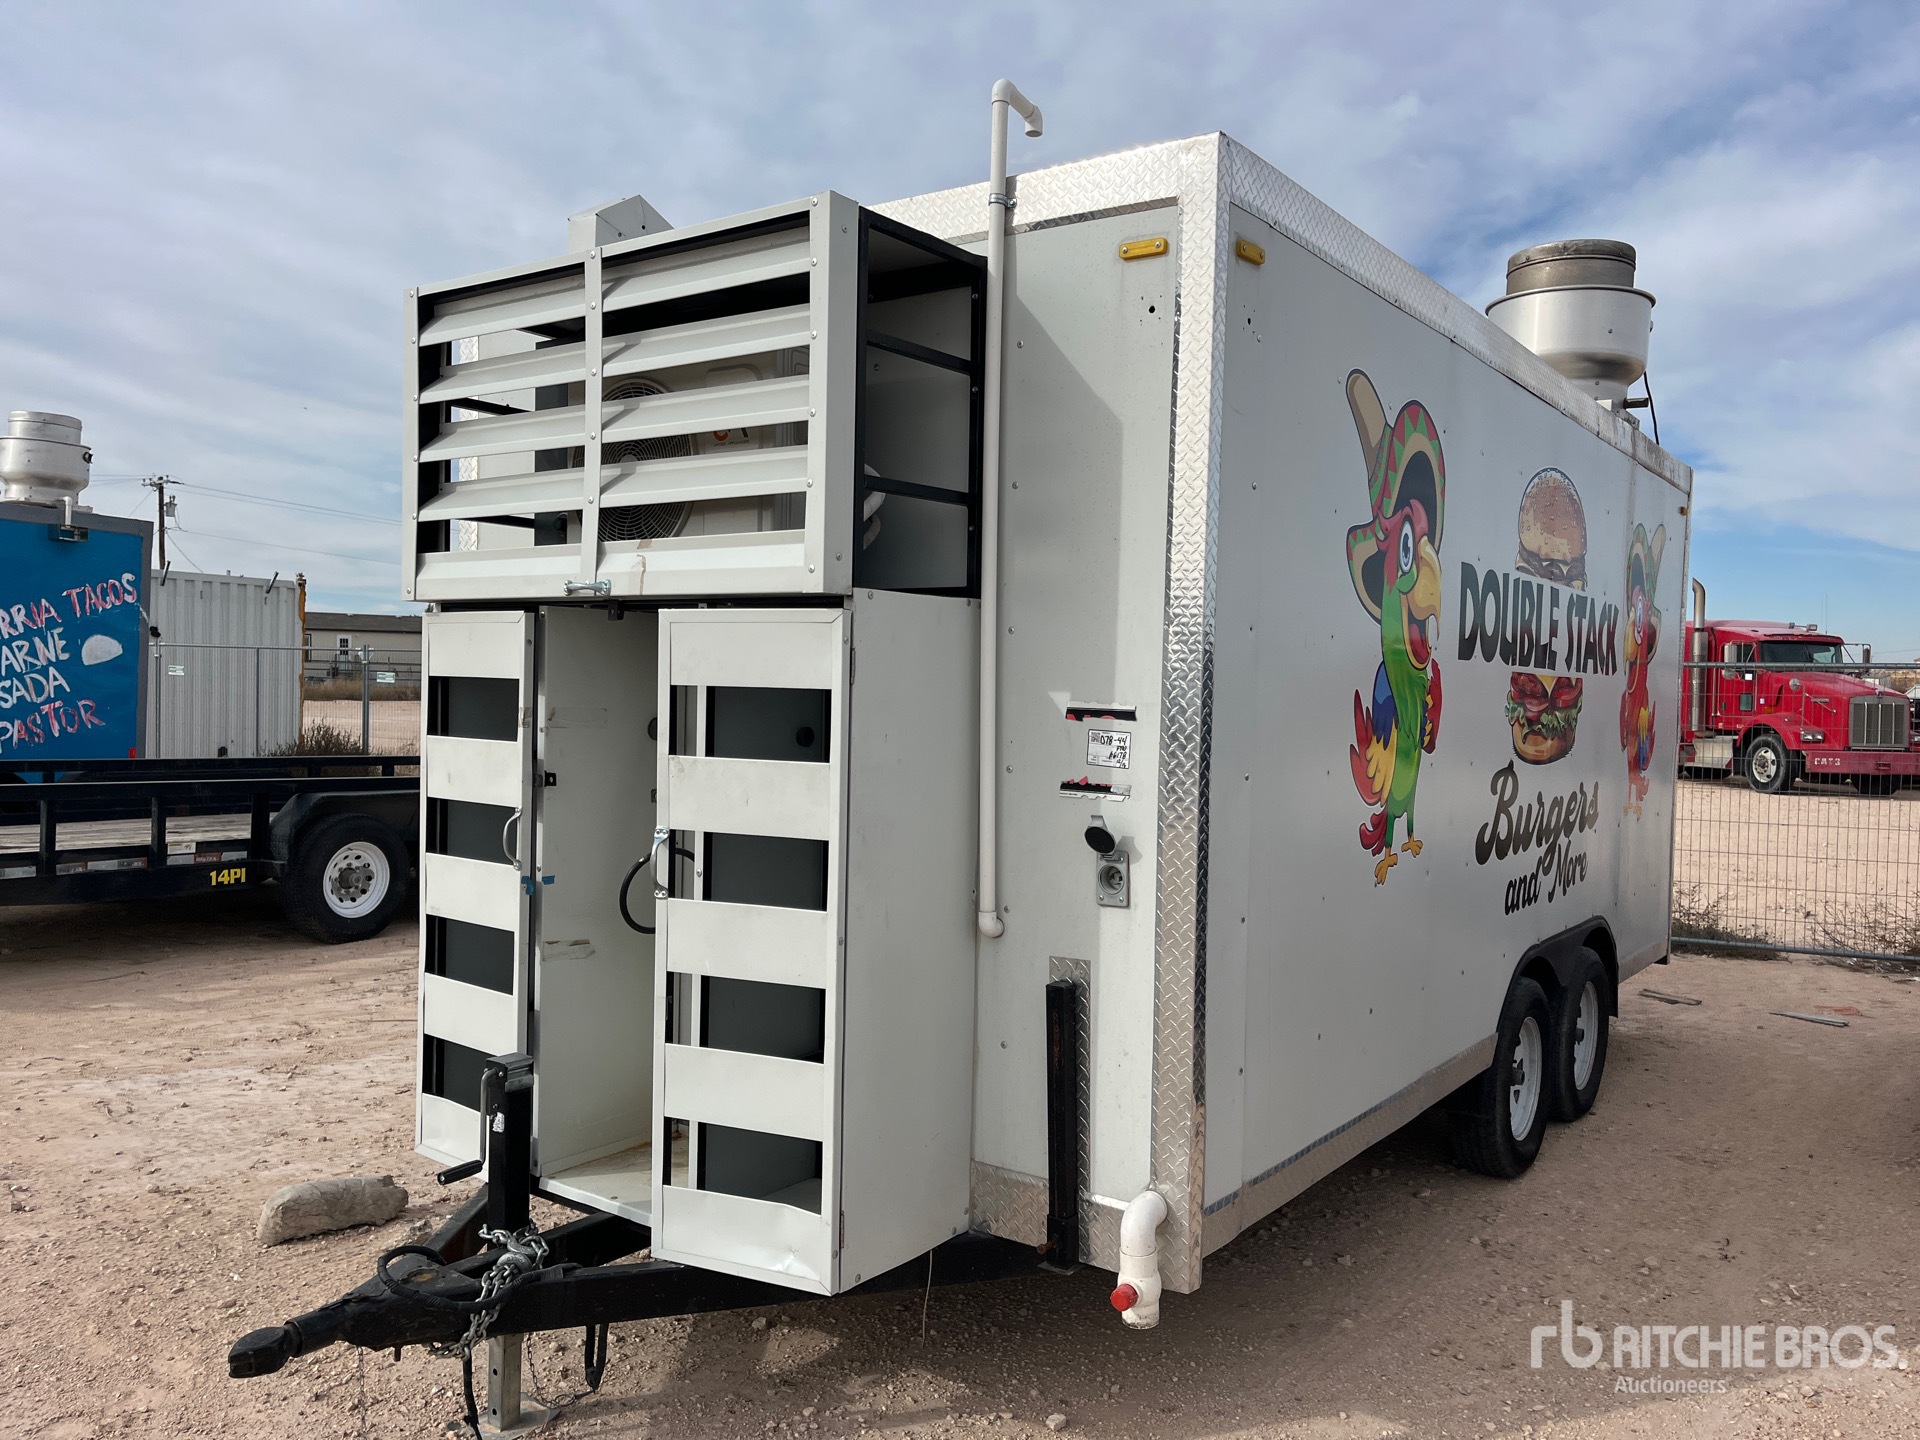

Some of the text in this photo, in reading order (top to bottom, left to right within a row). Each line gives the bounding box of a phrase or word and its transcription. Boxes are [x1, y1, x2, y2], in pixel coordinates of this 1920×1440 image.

[62, 573, 137, 617] TACOS
[1458, 562, 1619, 676] DOUBLE STACK
[1, 627, 70, 676] ARNE
[0, 666, 70, 709] SADA
[0, 699, 106, 754] PASTOR
[1475, 760, 1599, 876] Burgers
[1505, 840, 1589, 915] and More
